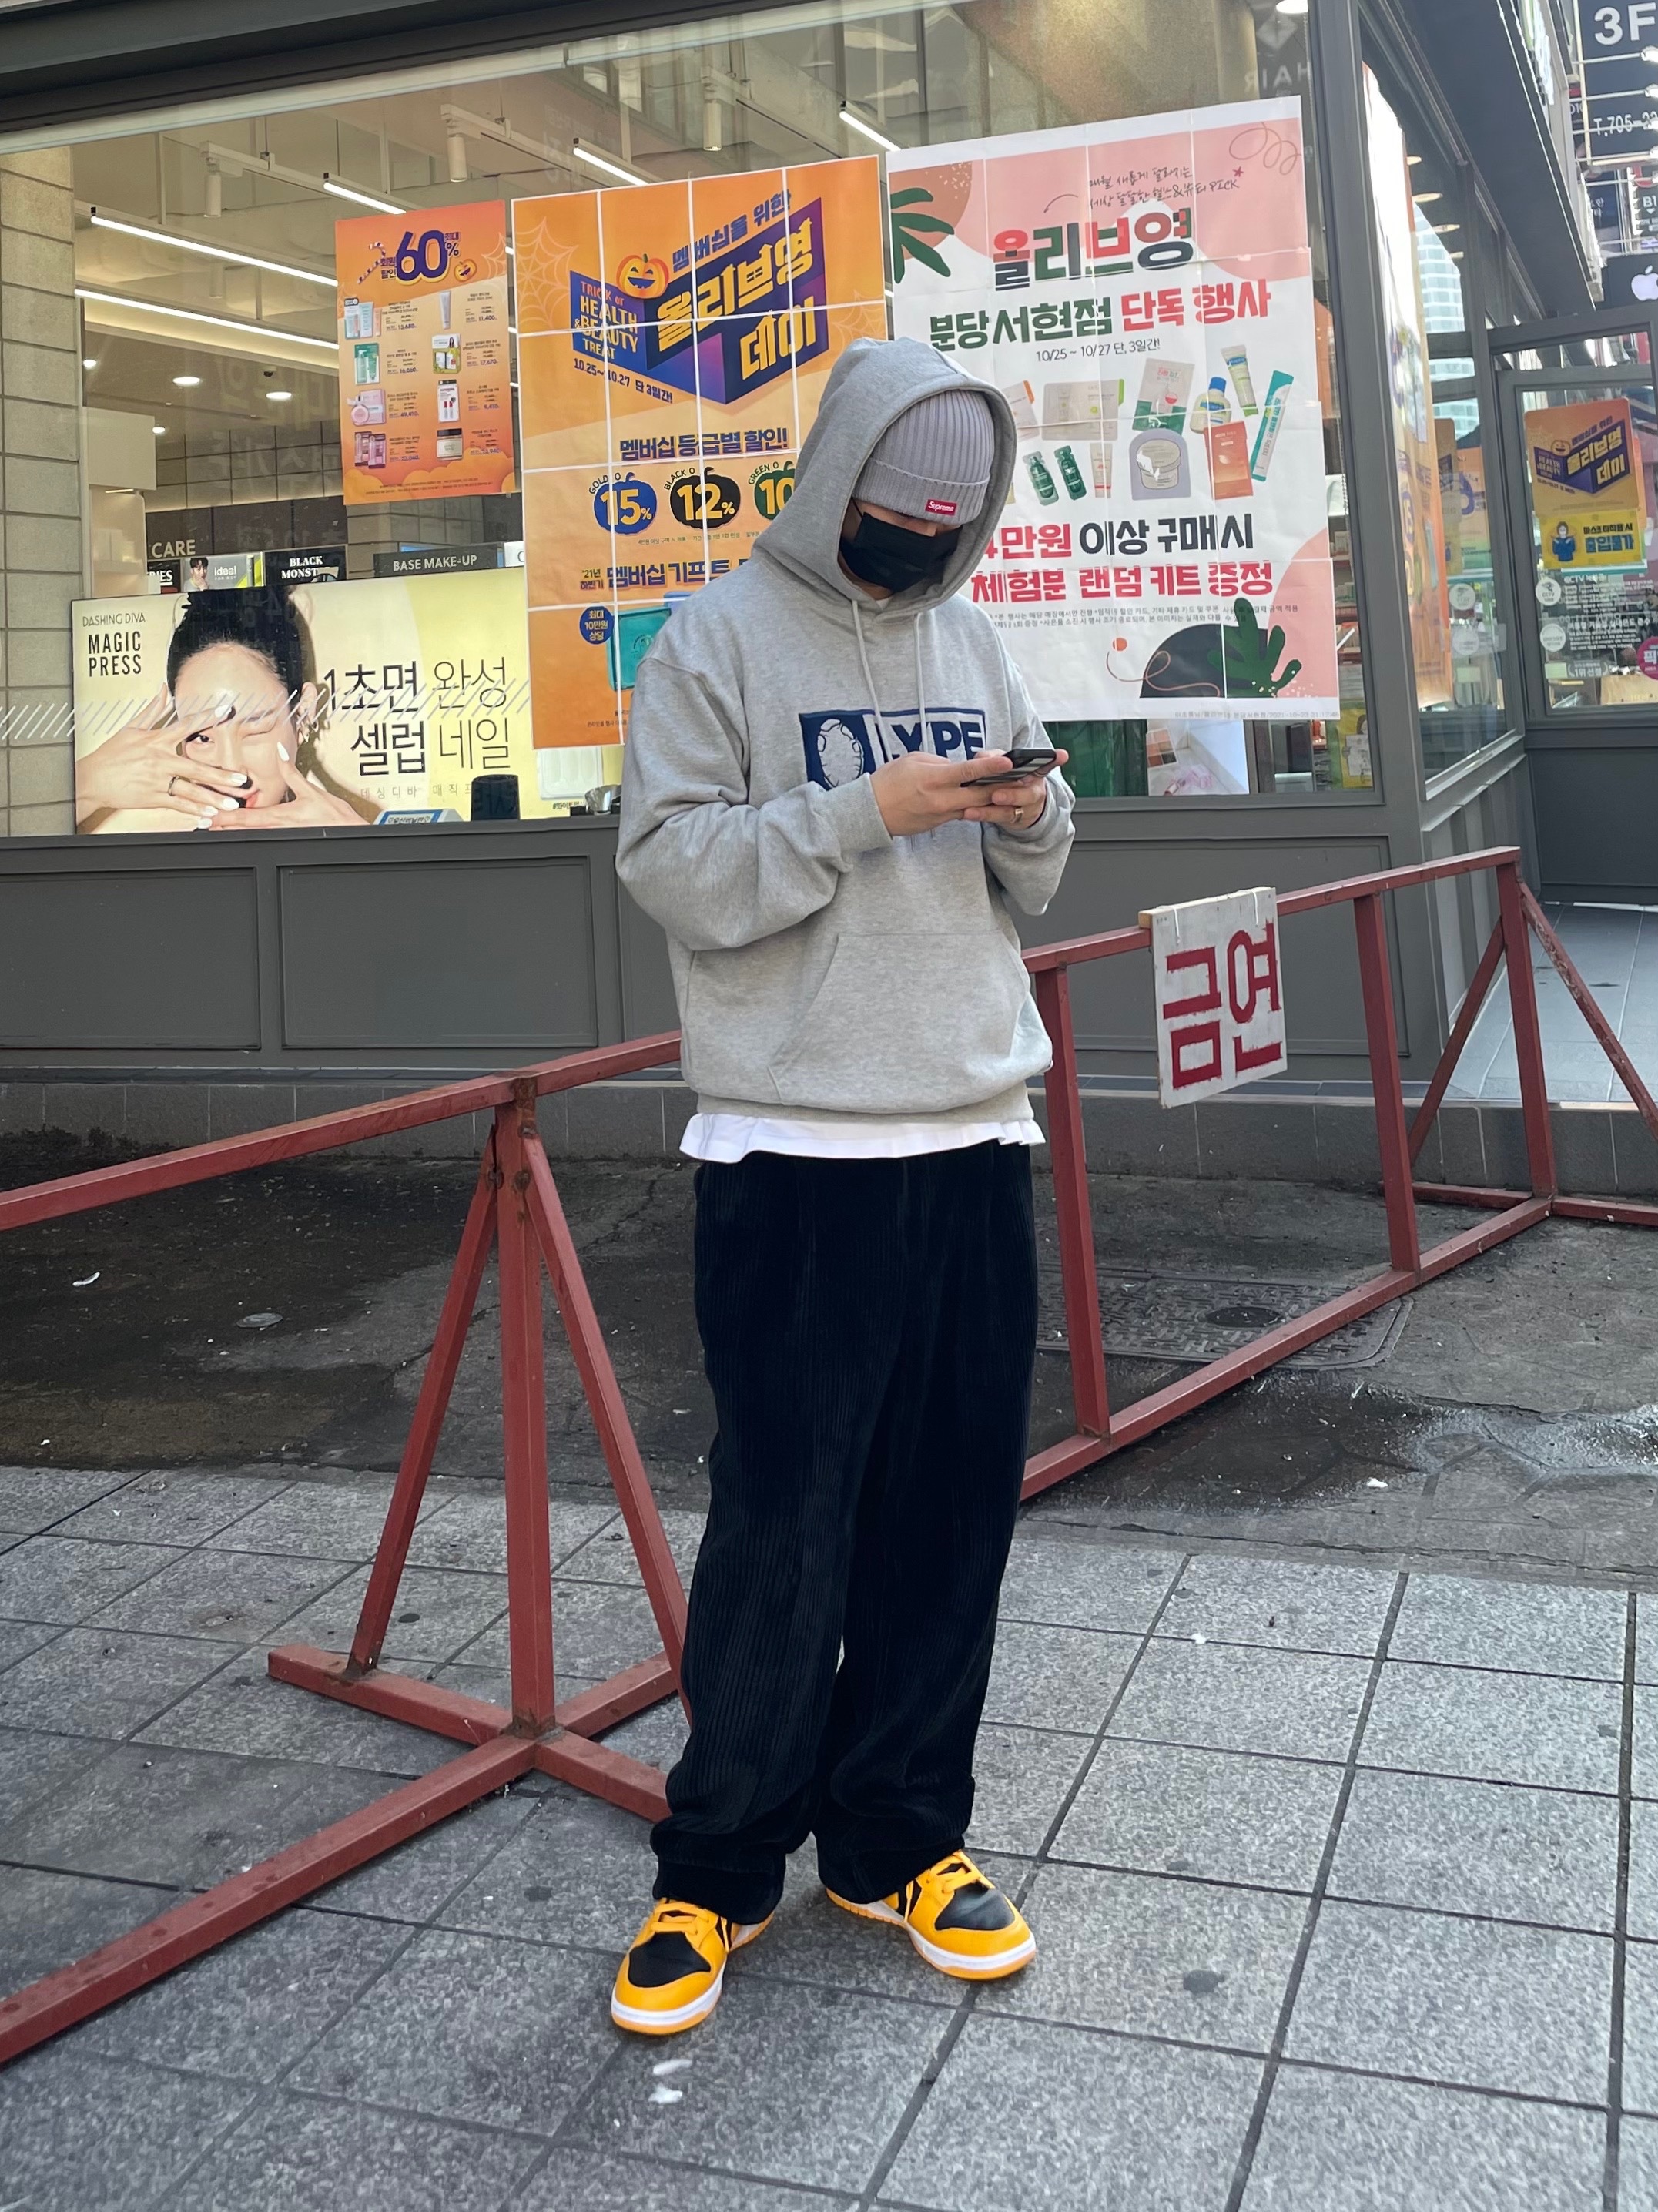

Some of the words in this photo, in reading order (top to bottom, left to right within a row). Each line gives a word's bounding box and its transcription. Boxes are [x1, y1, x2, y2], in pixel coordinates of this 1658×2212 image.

[1594, 2, 1656, 45] 3F
[672, 213, 749, 273] 멤버십을
[752, 188, 791, 227] 위한
[993, 207, 1194, 291] 올리브영
[580, 280, 612, 303] TRICK
[658, 217, 813, 352] 올리브영
[580, 295, 638, 333] HEALTH
[929, 297, 1113, 352] 분당서현점
[1121, 287, 1184, 332] 단독
[1192, 279, 1271, 323] 행사
[582, 338, 616, 360] TREAT
[739, 296, 816, 381] 데이
[1036, 347, 1067, 361] 10/25
[1080, 343, 1110, 359] 10/27
[1129, 337, 1161, 354] 3일간!
[620, 436, 675, 461] 멤버십
[678, 431, 741, 457] 등급별
[744, 428, 788, 454] 할인!
[1567, 425, 1622, 475] 올리브영
[664, 469, 686, 491] BLACK
[748, 464, 770, 486] GREEN
[1596, 453, 1625, 485] 데이
[589, 474, 608, 494] GOLD
[152, 539, 196, 558] CARE
[1080, 519, 1149, 555] 이상
[289, 555, 323, 568] BLACK
[393, 558, 421, 571] BASE
[424, 555, 477, 569] MAKE-UP
[607, 564, 666, 588] 멤버십
[668, 560, 730, 584] 기프트
[580, 579, 604, 590] 하반기
[1079, 564, 1143, 598] 랜덤
[1150, 563, 1201, 597] 키트
[1207, 560, 1272, 597] 증정
[82, 614, 123, 627] DASHING
[125, 612, 146, 625] DIVA
[584, 619, 608, 630] 10만원
[589, 609, 604, 620] 최대
[89, 632, 141, 654] MAGIC
[589, 631, 604, 641] 상당
[89, 654, 142, 677] PRESS
[323, 660, 418, 713] 1초면
[433, 657, 507, 710] 완성
[351, 721, 426, 776] 셀럽
[439, 718, 511, 771] 네일
[1162, 917, 1282, 1090] 금연
